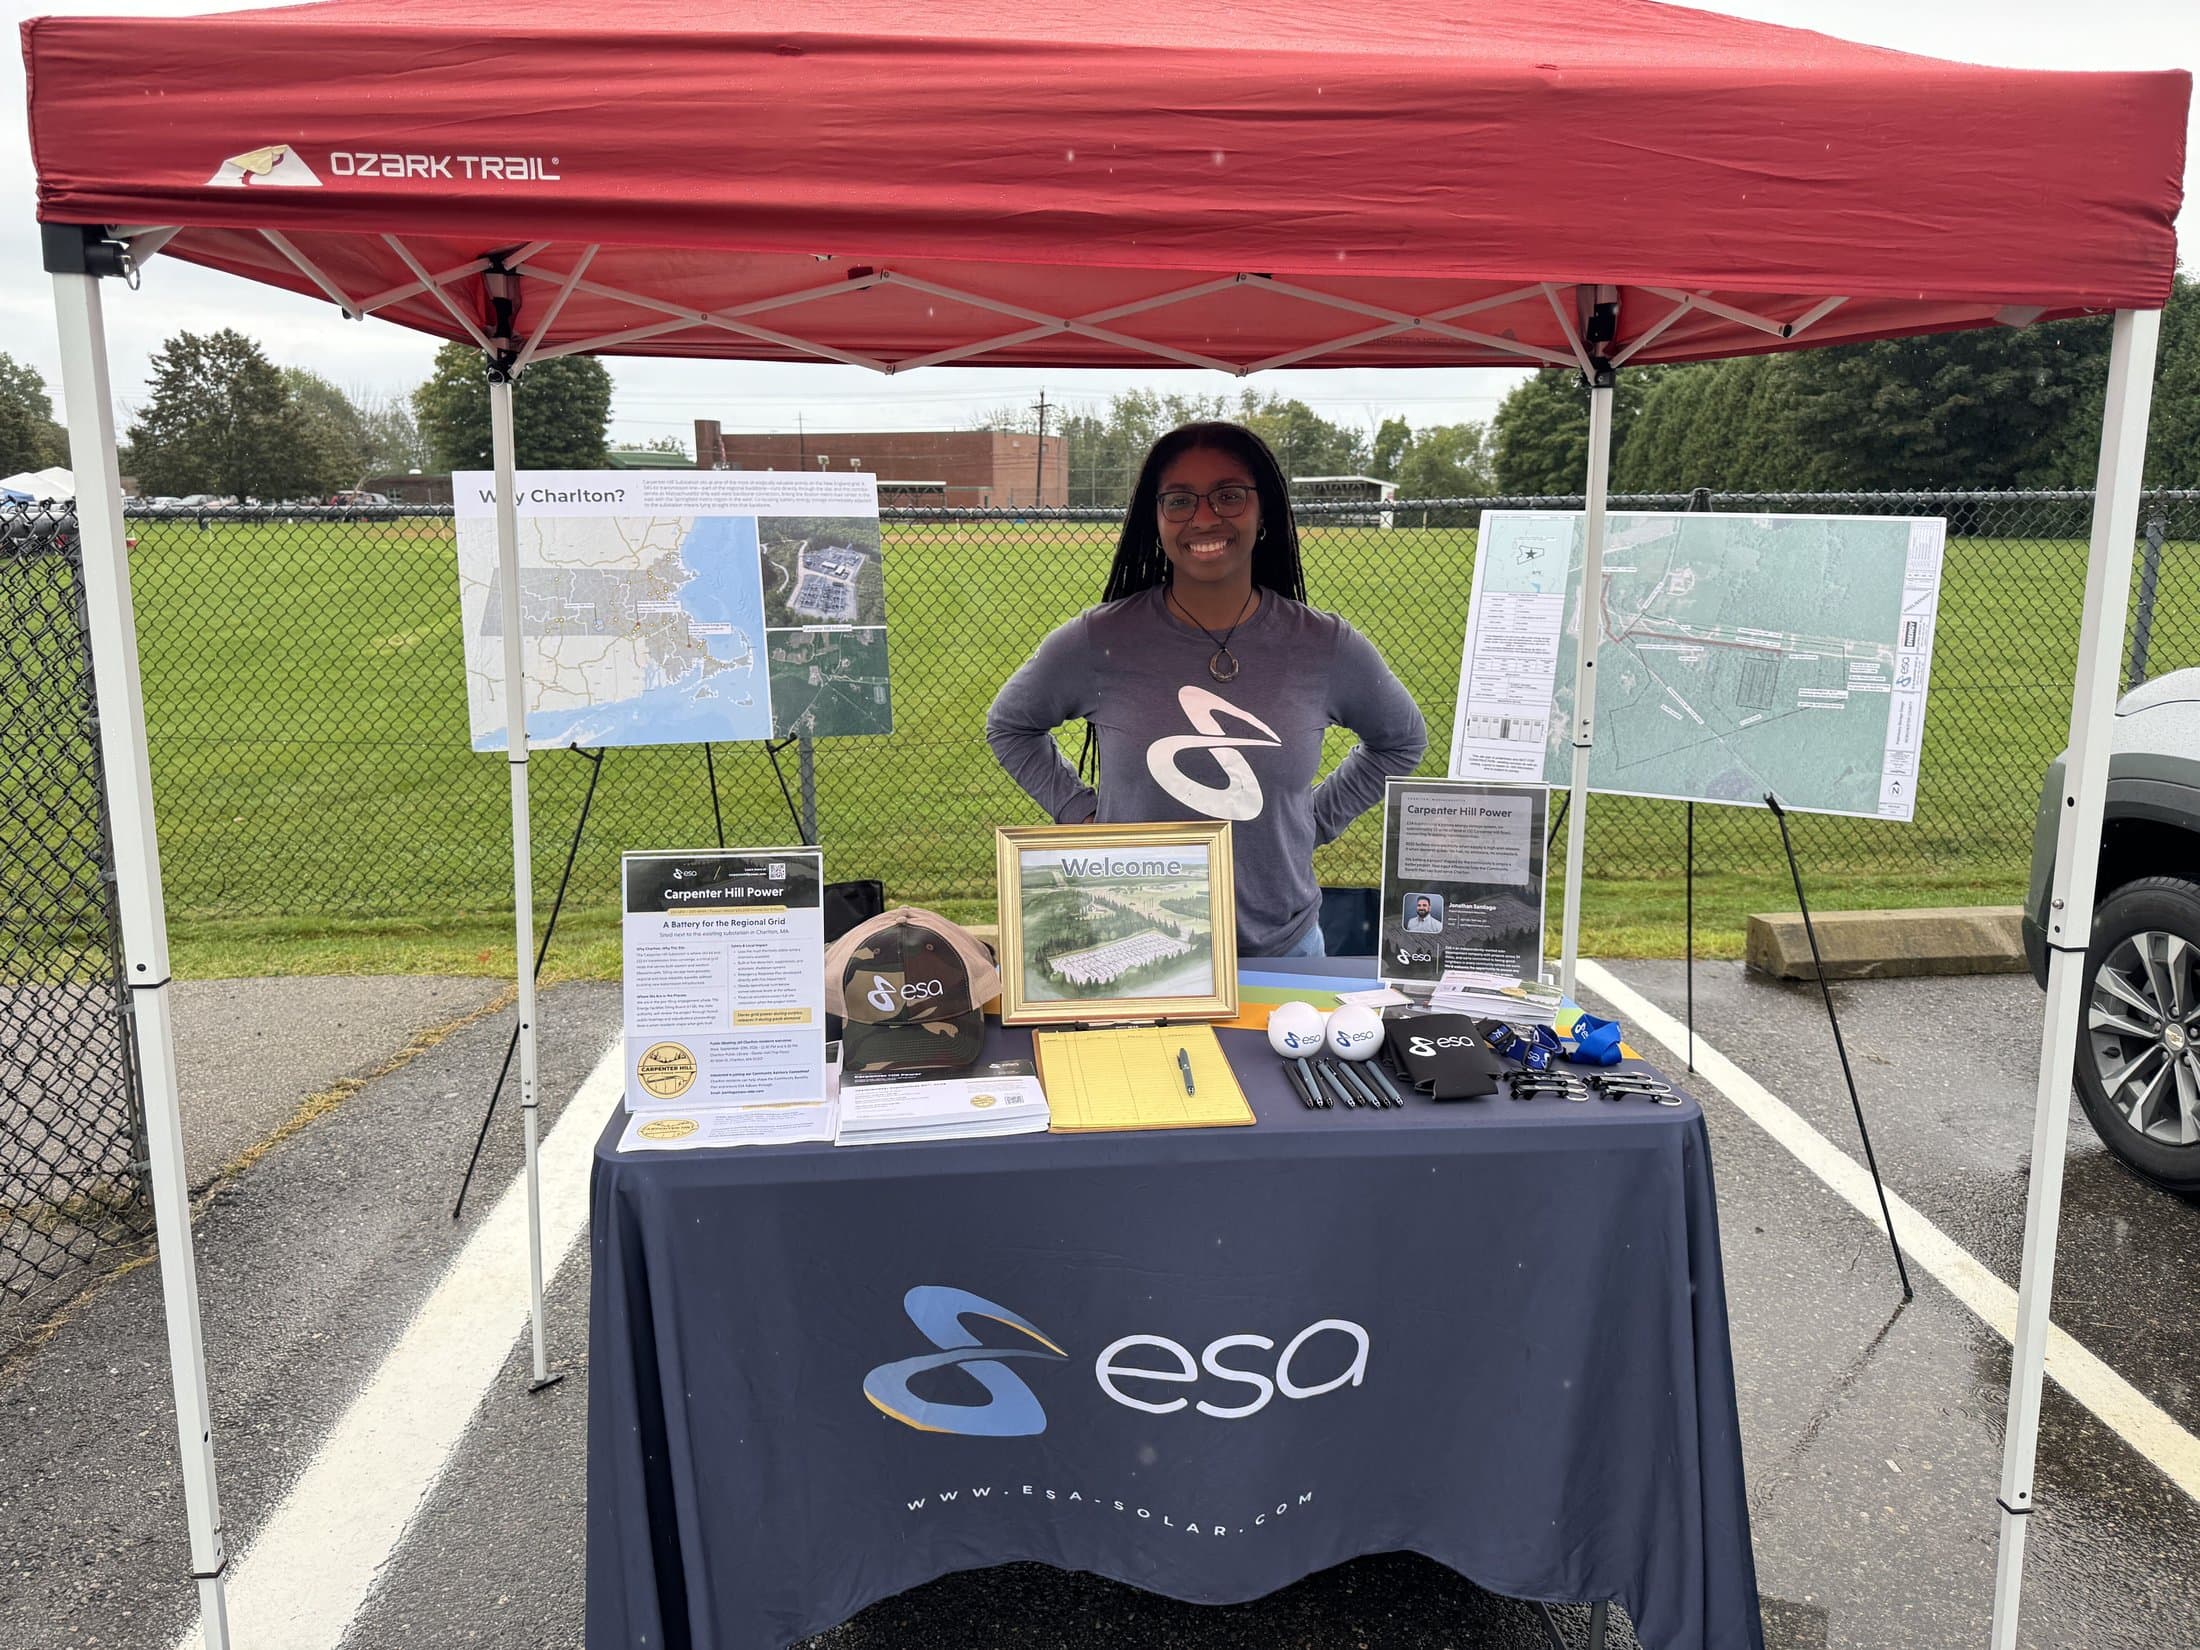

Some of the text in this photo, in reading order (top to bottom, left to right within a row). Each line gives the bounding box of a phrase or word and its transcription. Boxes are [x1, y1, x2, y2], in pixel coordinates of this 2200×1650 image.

[330, 152, 450, 179] OZARK
[479, 488, 625, 506] Wy Charlton?
[1901, 656, 1910, 674] esa
[1407, 805, 1512, 817] Carpenter Hill Power
[1061, 857, 1181, 876] Welcome
[664, 887, 784, 901] Carpenter Hill Power
[671, 921, 700, 930] Battery
[730, 918, 766, 928] Regional
[1411, 952, 1432, 962] esa
[901, 979, 944, 1000] esa
[1302, 1033, 1321, 1045] esa
[1352, 1030, 1374, 1042] esa
[1436, 1034, 1475, 1048] esa
[1096, 1318, 1370, 1419] esa
[907, 1485, 1313, 1537] WWW.ESA-SOLAR.COM
